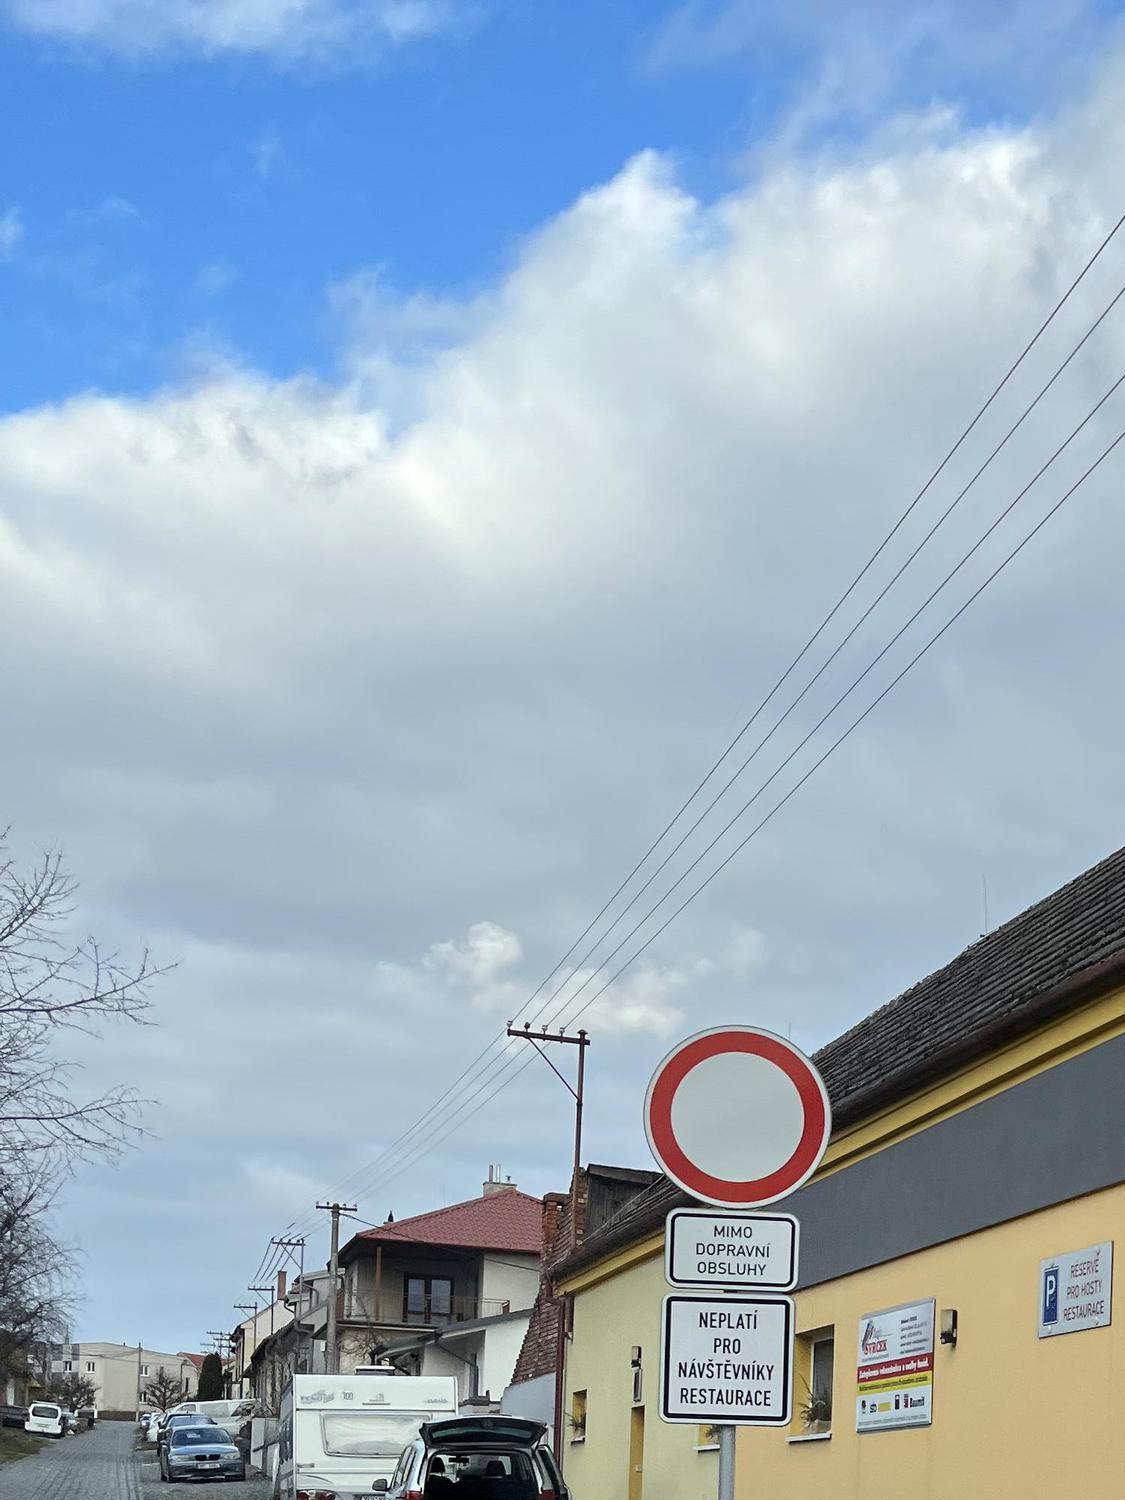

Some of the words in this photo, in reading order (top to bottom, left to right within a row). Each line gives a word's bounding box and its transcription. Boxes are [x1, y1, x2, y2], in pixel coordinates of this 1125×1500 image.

[713, 1225, 753, 1239] MIMO
[696, 1242, 771, 1258] DOPRAVNÍ
[697, 1261, 767, 1276] OBSLUHY
[1070, 1258, 1100, 1278] RESERVE
[1046, 1274, 1057, 1308] P
[1066, 1283, 1080, 1300] PRO
[1081, 1279, 1104, 1297] HOSTY
[699, 1309, 759, 1330] NEPLATÍ
[1063, 1299, 1105, 1322] RESTAURACE
[713, 1338, 742, 1354] PRO
[678, 1359, 775, 1381] NÁVŠTĚVNÍKY
[680, 1388, 772, 1407] RESTAURACE
